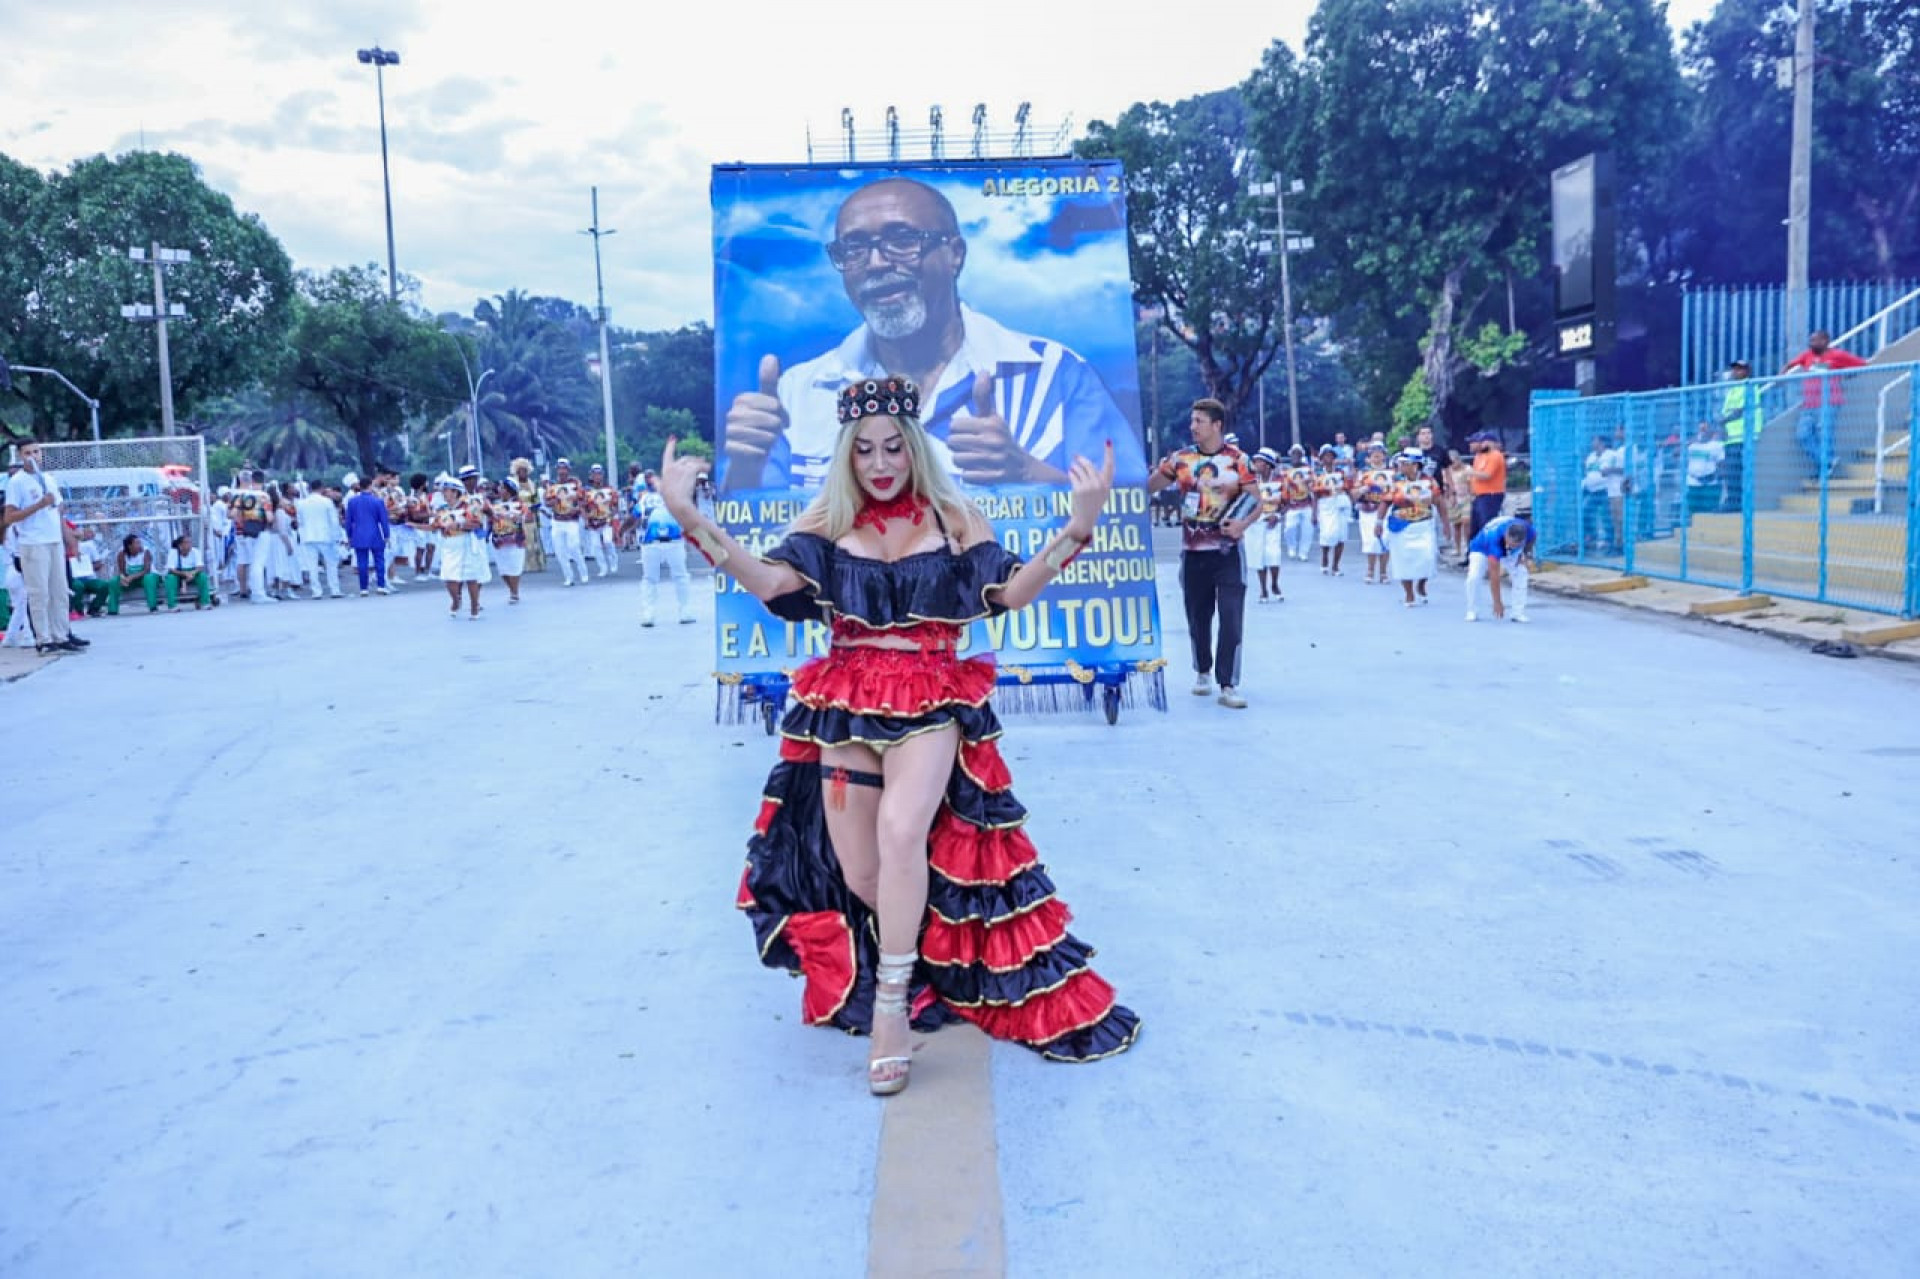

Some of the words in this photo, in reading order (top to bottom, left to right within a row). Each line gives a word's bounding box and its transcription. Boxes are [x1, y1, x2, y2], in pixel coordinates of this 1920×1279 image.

[983, 176, 1100, 195] ALEGORIA
[1107, 177, 1120, 193] 2
[715, 500, 753, 523] VOA
[762, 500, 801, 523] MEU
[974, 495, 1025, 518] SCAR
[1052, 488, 1146, 516] INITO
[1004, 529, 1019, 554] O
[722, 623, 738, 657] E
[748, 623, 768, 657] A
[985, 596, 1154, 651] VOLTOU!
